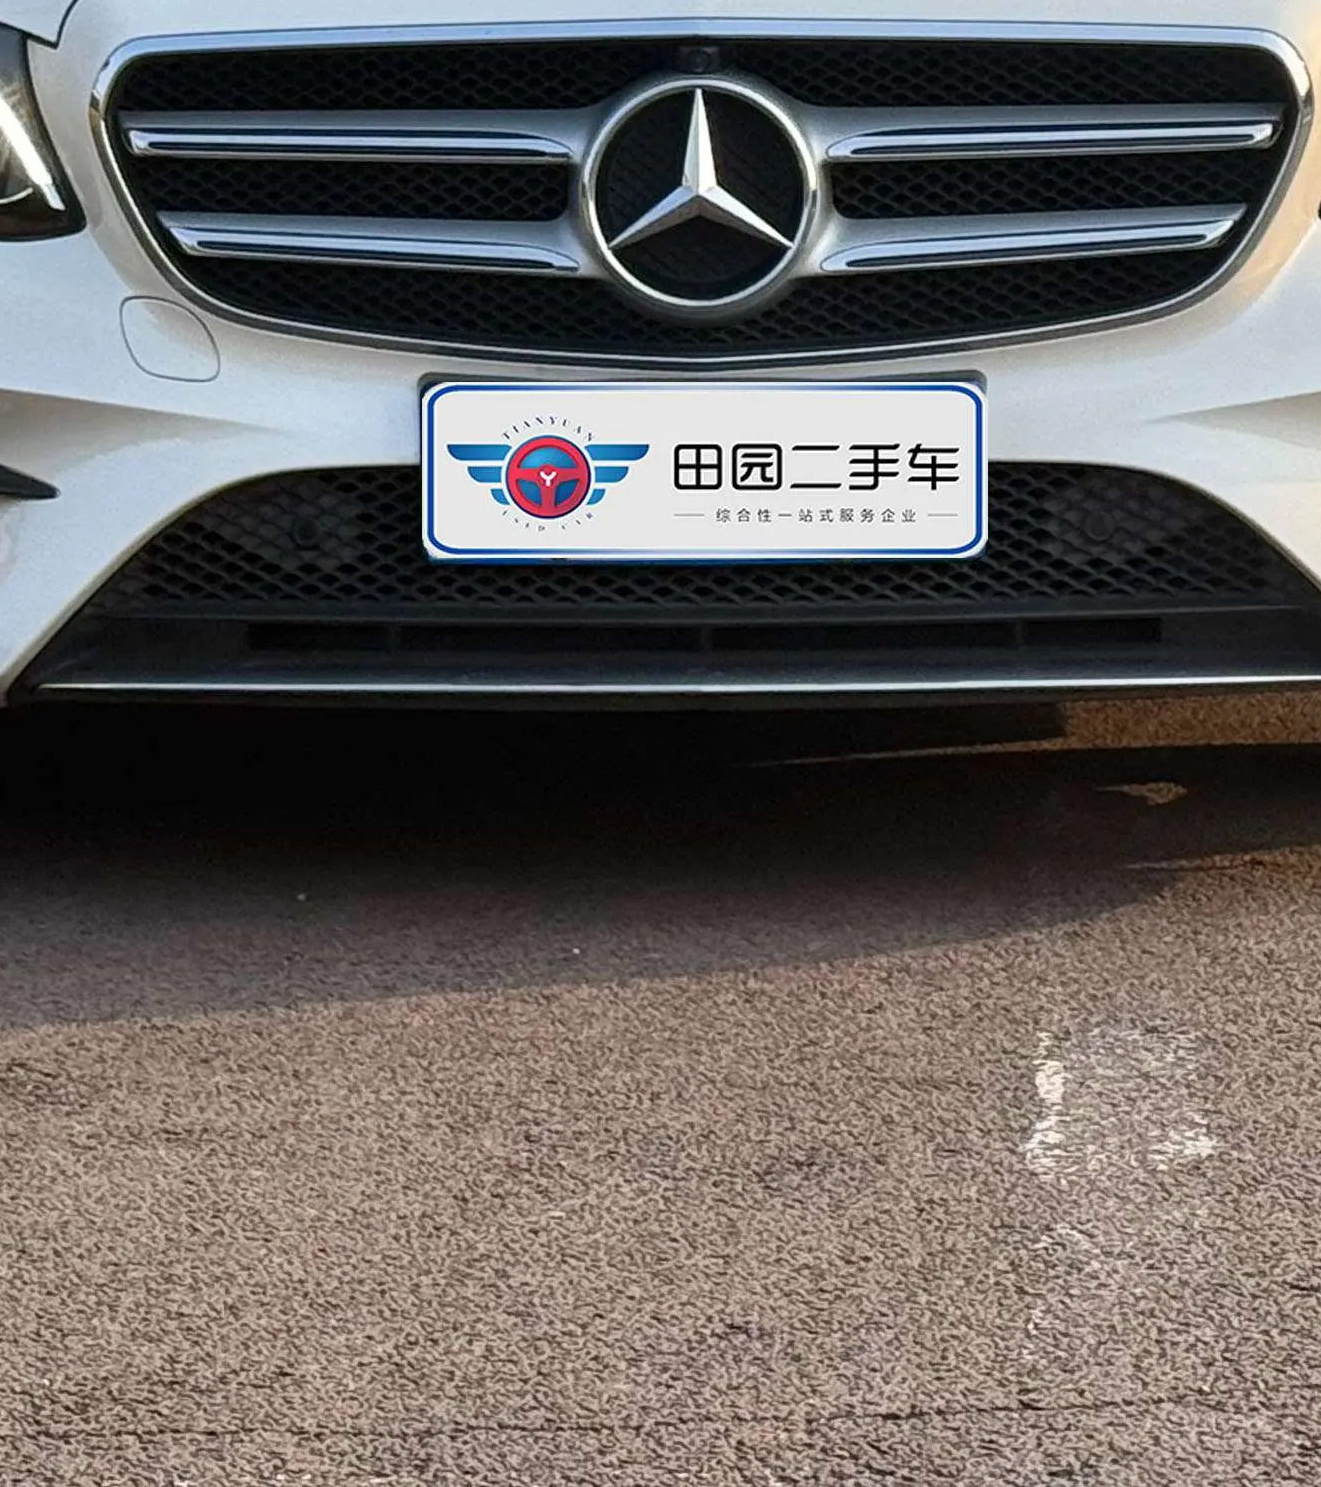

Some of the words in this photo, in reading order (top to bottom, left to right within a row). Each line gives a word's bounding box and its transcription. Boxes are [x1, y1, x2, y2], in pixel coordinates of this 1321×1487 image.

[673, 443, 960, 491] 田园二手车
[715, 507, 917, 524] 综合性一站式服务企业
